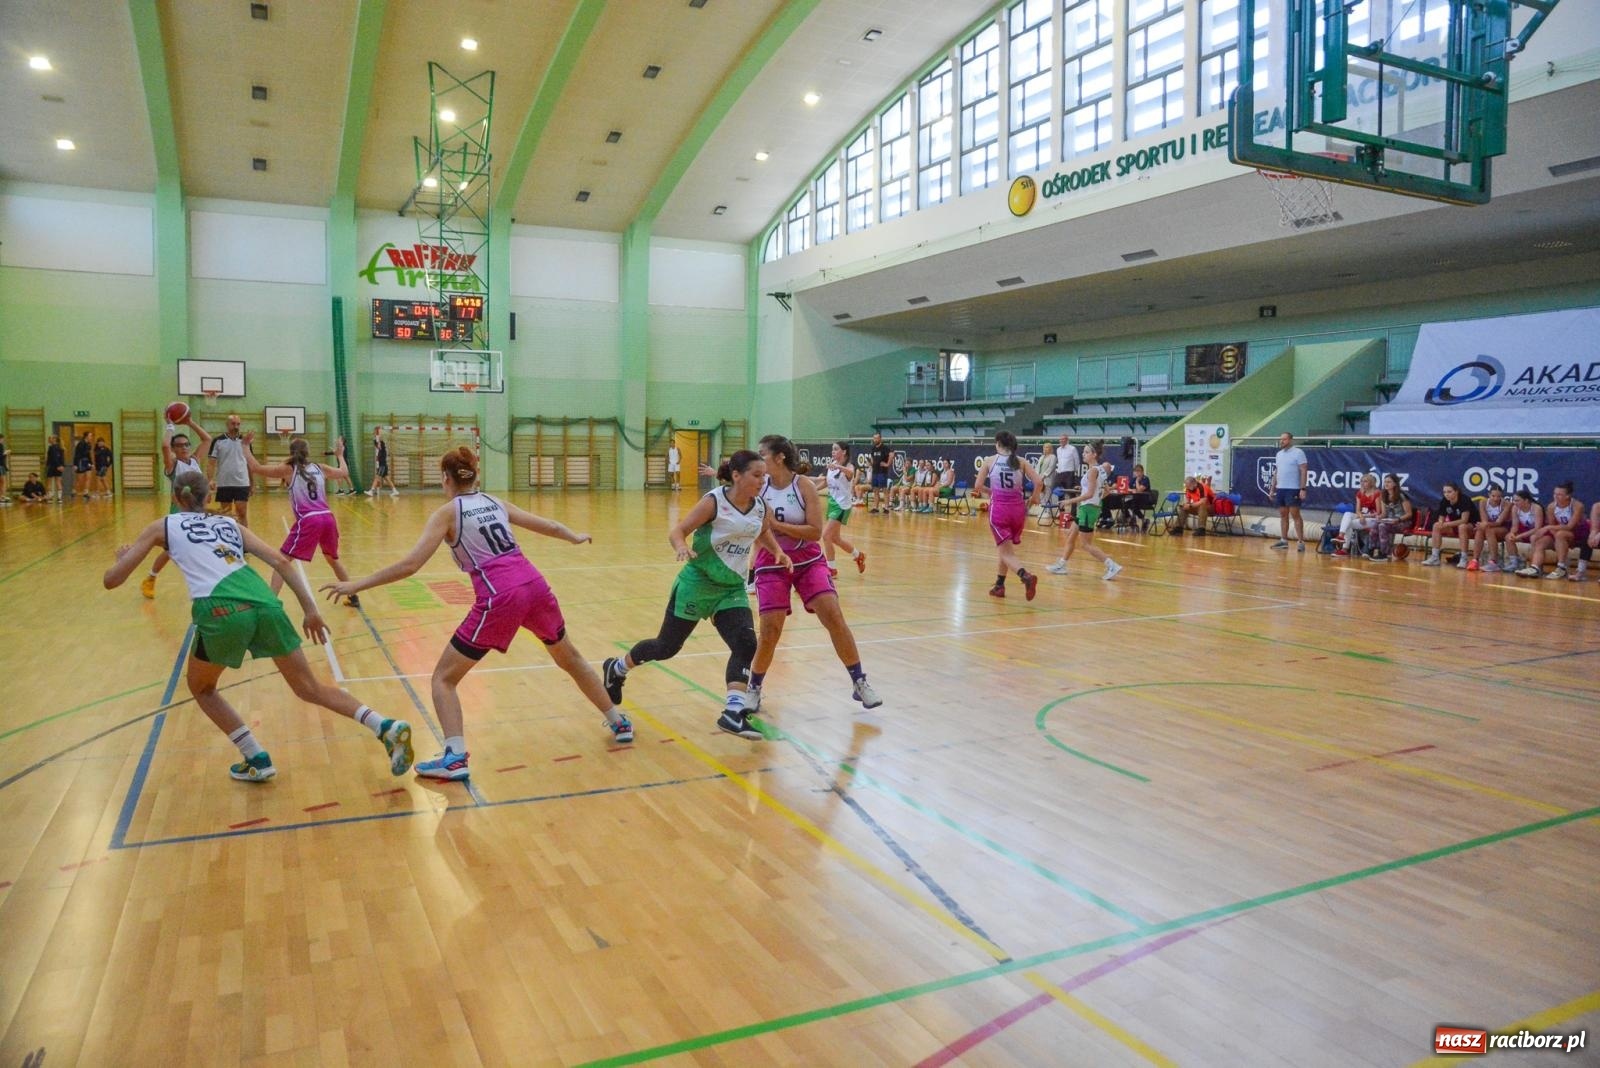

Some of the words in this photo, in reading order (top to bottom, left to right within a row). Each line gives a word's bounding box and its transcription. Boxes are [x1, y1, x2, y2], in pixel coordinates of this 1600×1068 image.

[1042, 160, 1112, 199] OŚRODEK
[1116, 136, 1185, 177] SPORTU
[1504, 386, 1552, 396] NAUK
[999, 471, 1014, 489] 15
[1119, 477, 1127, 490] 5
[307, 480, 318, 501] 8
[774, 506, 785, 522] 6
[479, 522, 516, 556] 10
